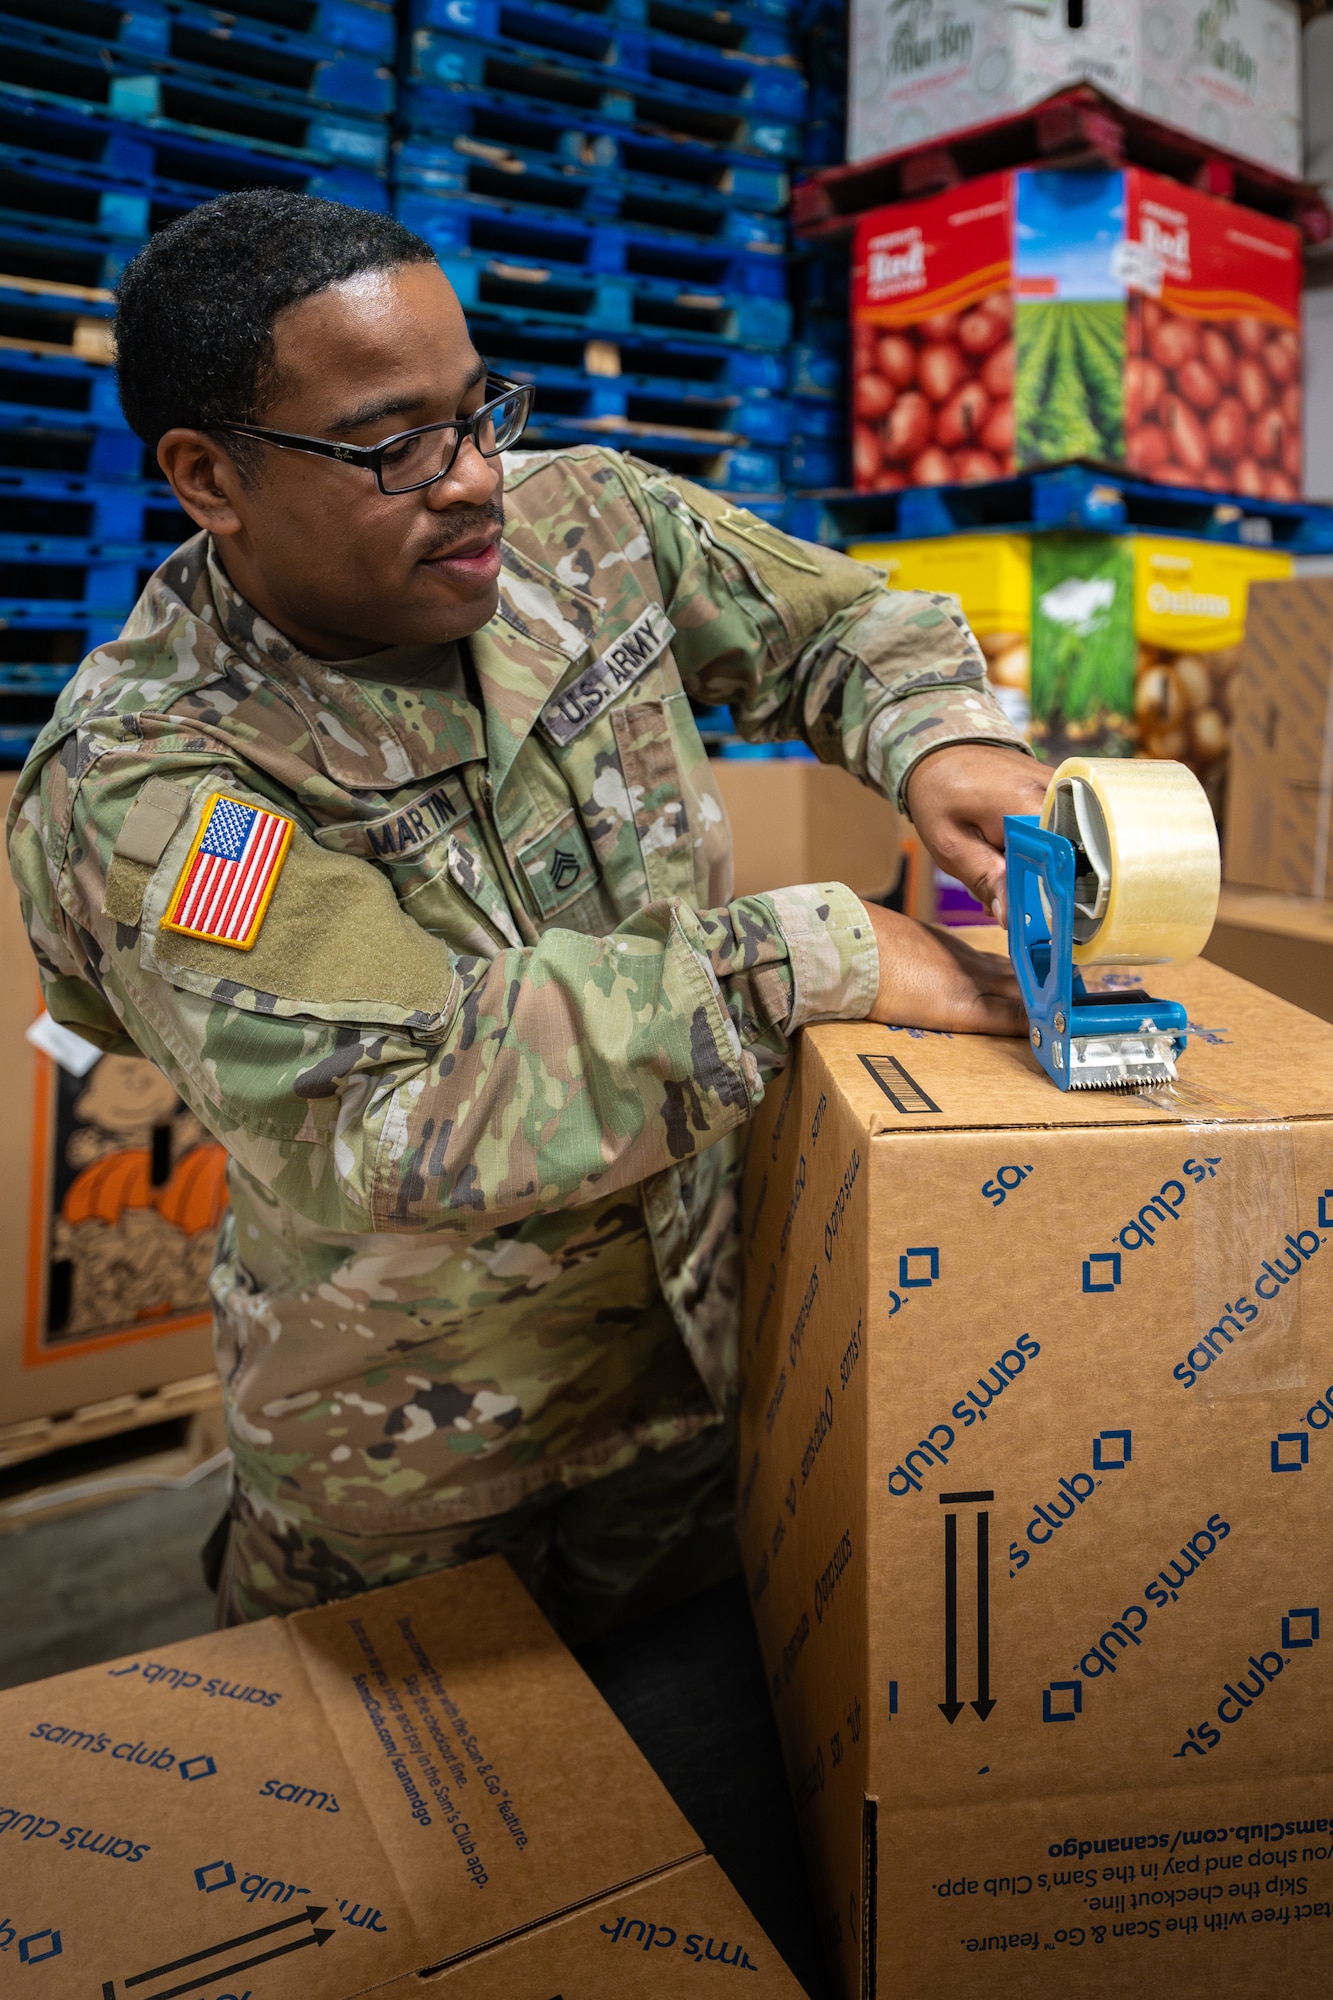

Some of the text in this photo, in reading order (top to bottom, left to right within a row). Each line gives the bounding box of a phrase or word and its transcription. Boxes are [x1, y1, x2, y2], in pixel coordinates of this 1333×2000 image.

[605, 619, 661, 687] ARMY
[366, 788, 458, 857] MARTIN
[981, 1165, 1034, 1207] sa
[1118, 1179, 1186, 1251] club
[1173, 1296, 1259, 1389] sam's
[1255, 1229, 1321, 1300] club
[888, 1333, 1041, 1496] sam's club
[1026, 1473, 1095, 1545] club
[1080, 1513, 1231, 1678] sam's club
[142, 1663, 282, 1707] sam's club
[1217, 1651, 1284, 1724] club
[396, 1713, 419, 1733] and
[29, 1722, 176, 1772] sam's club
[403, 1733, 425, 1754] pay
[423, 1714, 458, 1764] checkout
[448, 1762, 468, 1789] line.
[416, 1752, 432, 1767] in
[423, 1766, 440, 1788] the
[434, 1786, 461, 1824] Sam's
[462, 1735, 484, 1765] Scan
[477, 1764, 493, 1776] &
[496, 1800, 528, 1851] feature.
[0, 1808, 151, 1863] sam's club
[452, 1823, 477, 1855] Club
[1163, 1855, 1200, 1875] pay
[1205, 1854, 1244, 1876] and
[1248, 1849, 1298, 1869] shop
[466, 1856, 489, 1890] app.
[1037, 1868, 1098, 1893] Sam's
[1102, 1865, 1136, 1885] the
[1140, 1863, 1159, 1882] in
[931, 1877, 980, 1898] app.
[983, 1875, 1034, 1897] Club
[1083, 1875, 1309, 1914] Skip the checkout line.
[1203, 1911, 1248, 1933] with
[1250, 1906, 1291, 1926] free
[1295, 1902, 1333, 1922] tact
[1090, 1925, 1108, 1945] &
[1112, 1919, 1162, 1940] Scan
[1165, 1915, 1200, 1935] the
[960, 1931, 1041, 1953] feature.
